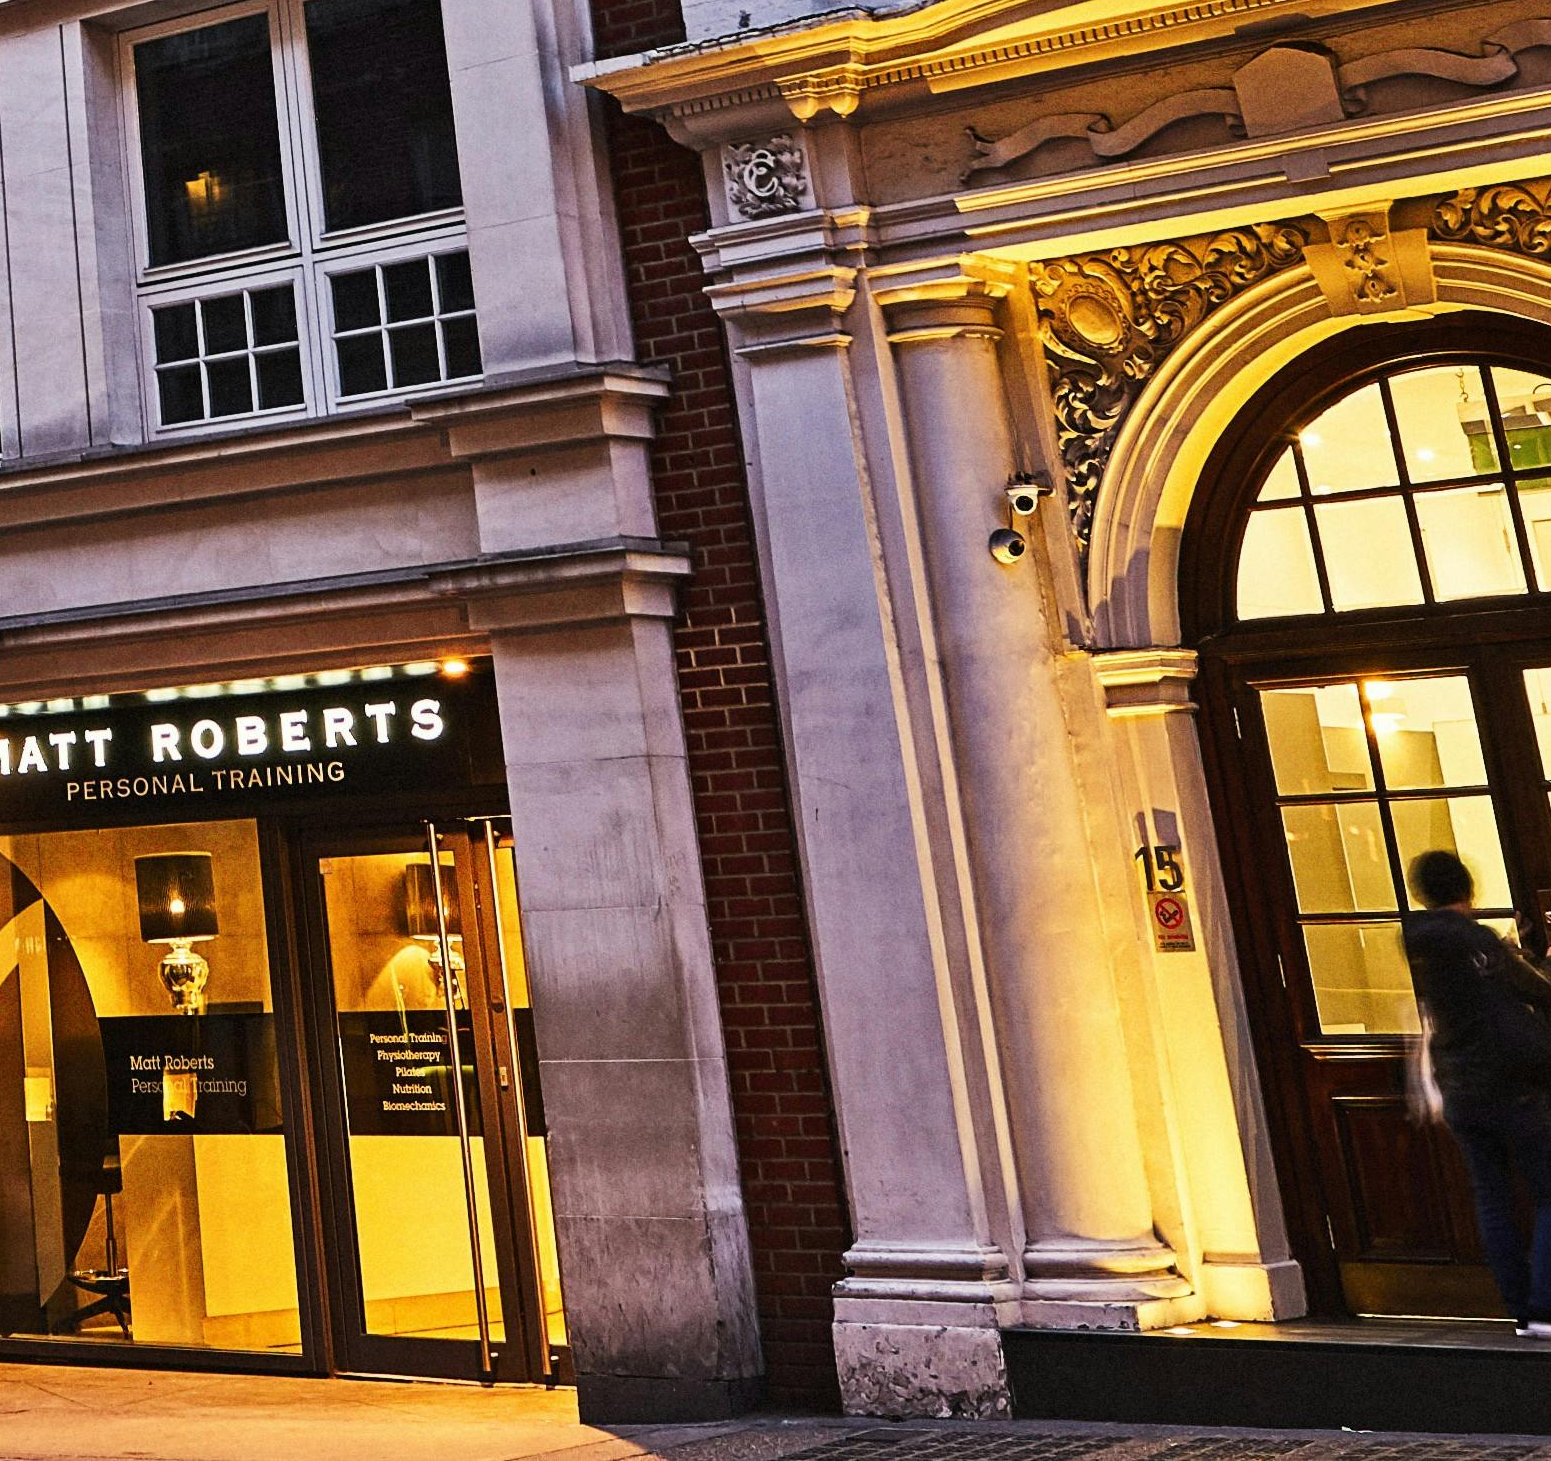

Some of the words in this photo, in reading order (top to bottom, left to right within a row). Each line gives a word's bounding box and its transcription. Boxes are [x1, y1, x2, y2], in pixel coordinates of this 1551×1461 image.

[149, 698, 445, 764] ROBERTS
[65, 774, 204, 802] PERSONAL
[211, 761, 347, 791] TRAINING
[1134, 845, 1184, 891] 15
[369, 1033, 408, 1044] Personal
[408, 1032, 448, 1044] Training
[129, 1055, 161, 1071] Matt
[163, 1054, 215, 1071] Roberts
[377, 1050, 441, 1062] Physiotherapy
[395, 1066, 426, 1077] Pilates
[190, 1077, 247, 1097] Training
[392, 1083, 433, 1095] Nutrition
[382, 1100, 446, 1111] Biomechanics
